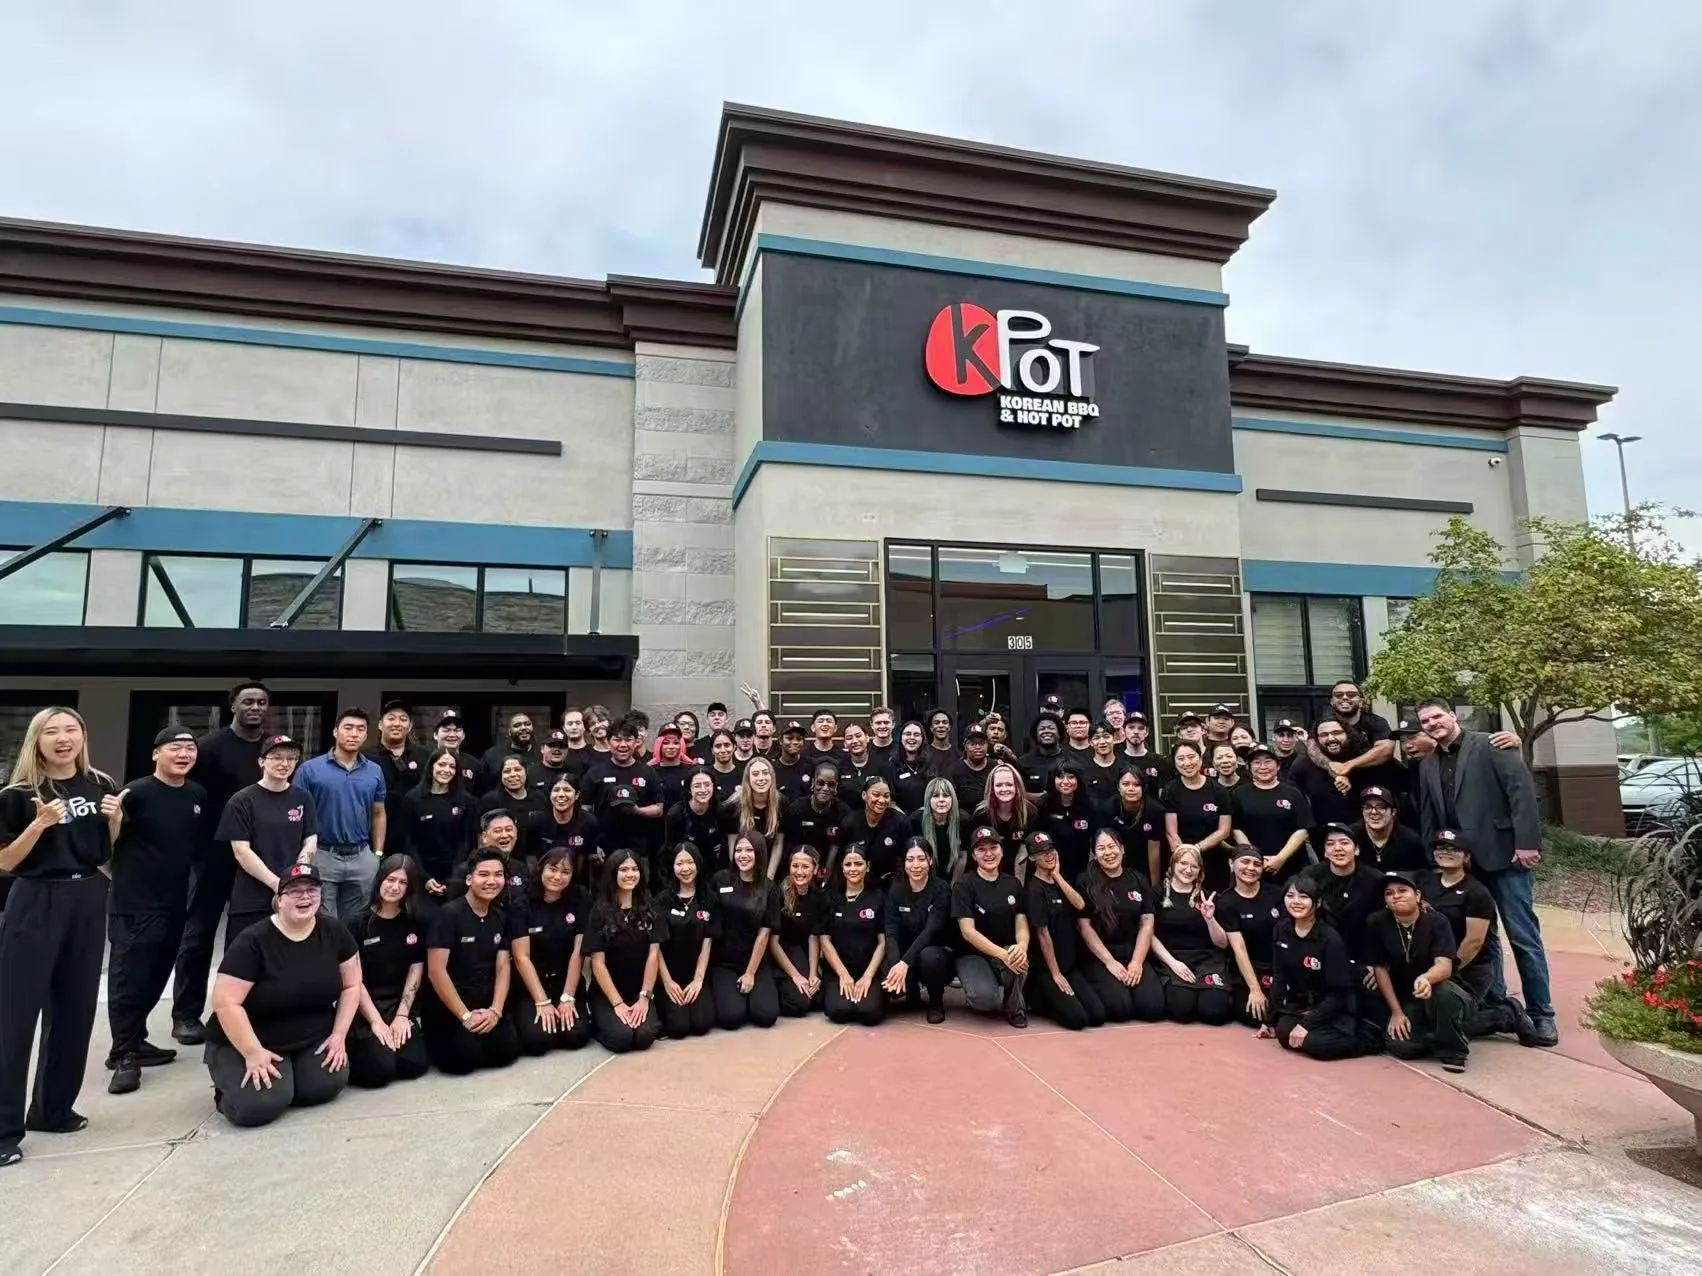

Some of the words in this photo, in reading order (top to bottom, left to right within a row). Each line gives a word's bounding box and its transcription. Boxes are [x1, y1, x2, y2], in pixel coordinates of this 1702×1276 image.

[1000, 396, 1065, 414] KOREAN
[1067, 402, 1100, 417] BBQ
[1000, 408, 1014, 423] &
[1017, 410, 1049, 426] HOT
[1051, 413, 1083, 429] POT
[1008, 636, 1032, 649] 305
